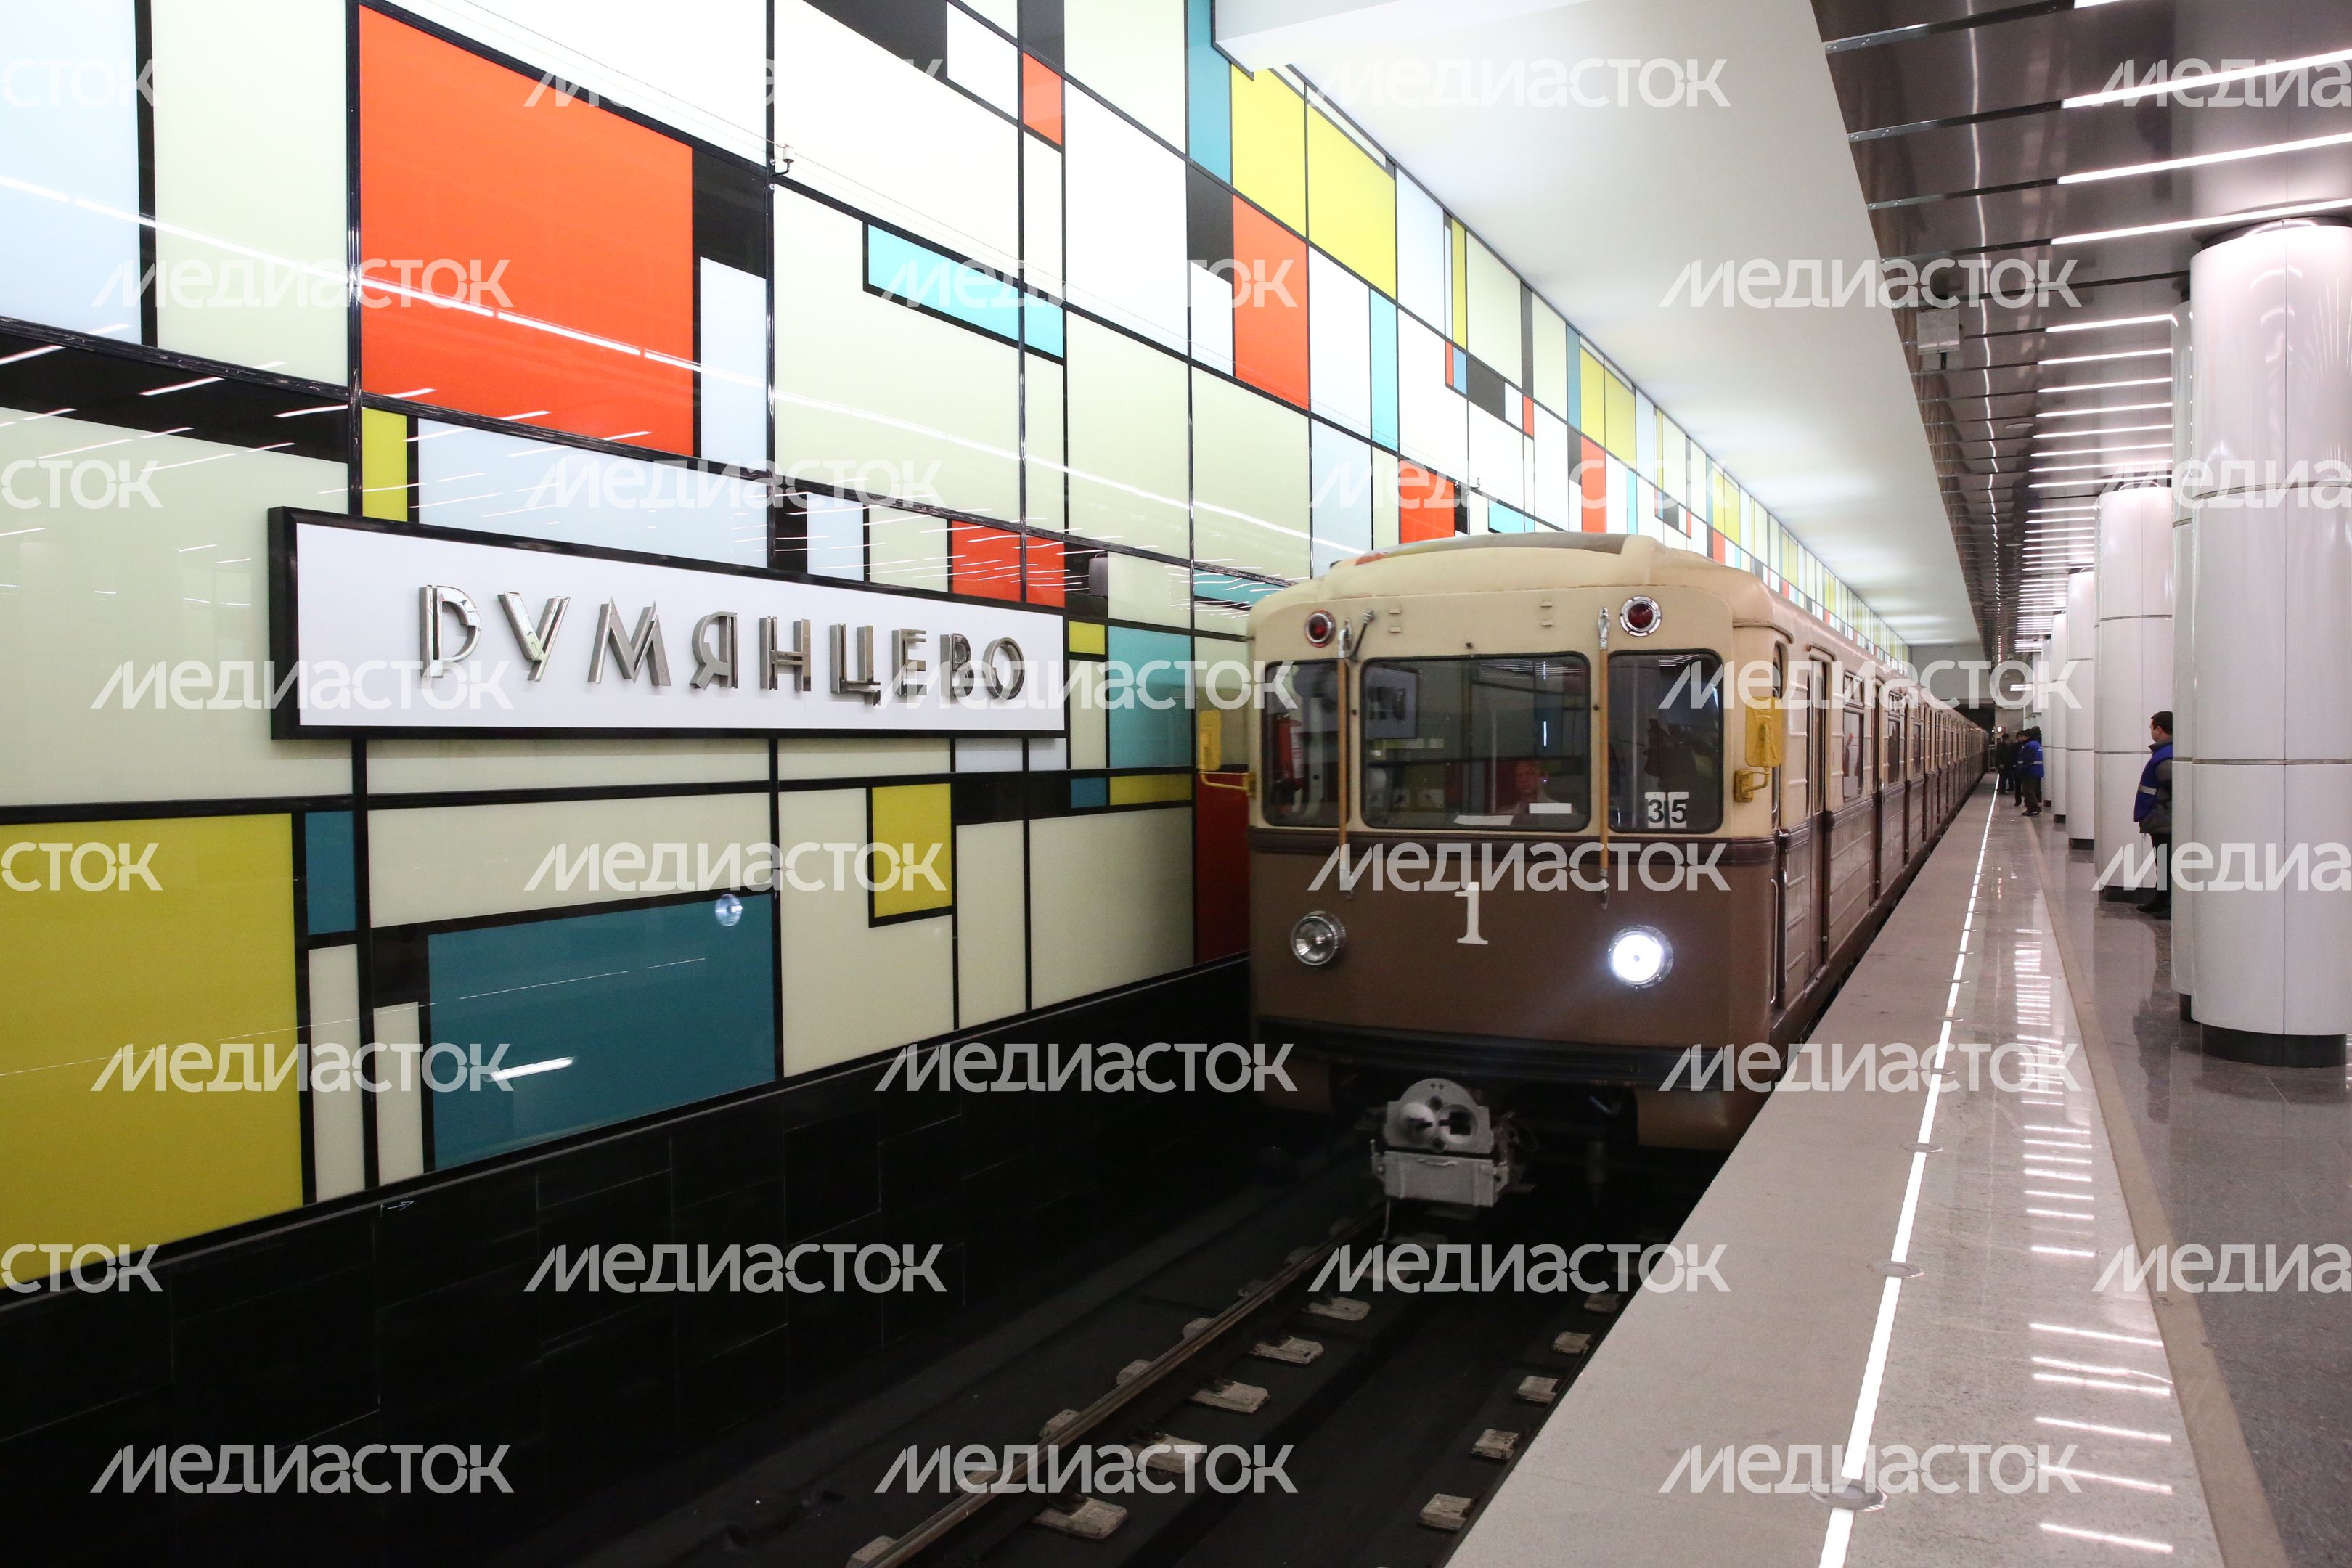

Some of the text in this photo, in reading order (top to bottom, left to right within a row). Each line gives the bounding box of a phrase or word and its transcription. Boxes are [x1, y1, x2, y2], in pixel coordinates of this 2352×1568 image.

[418, 584, 1025, 705] РУМЯНЦЕВО
[1649, 799, 1686, 823] 35
[1455, 882, 1488, 944] 1
